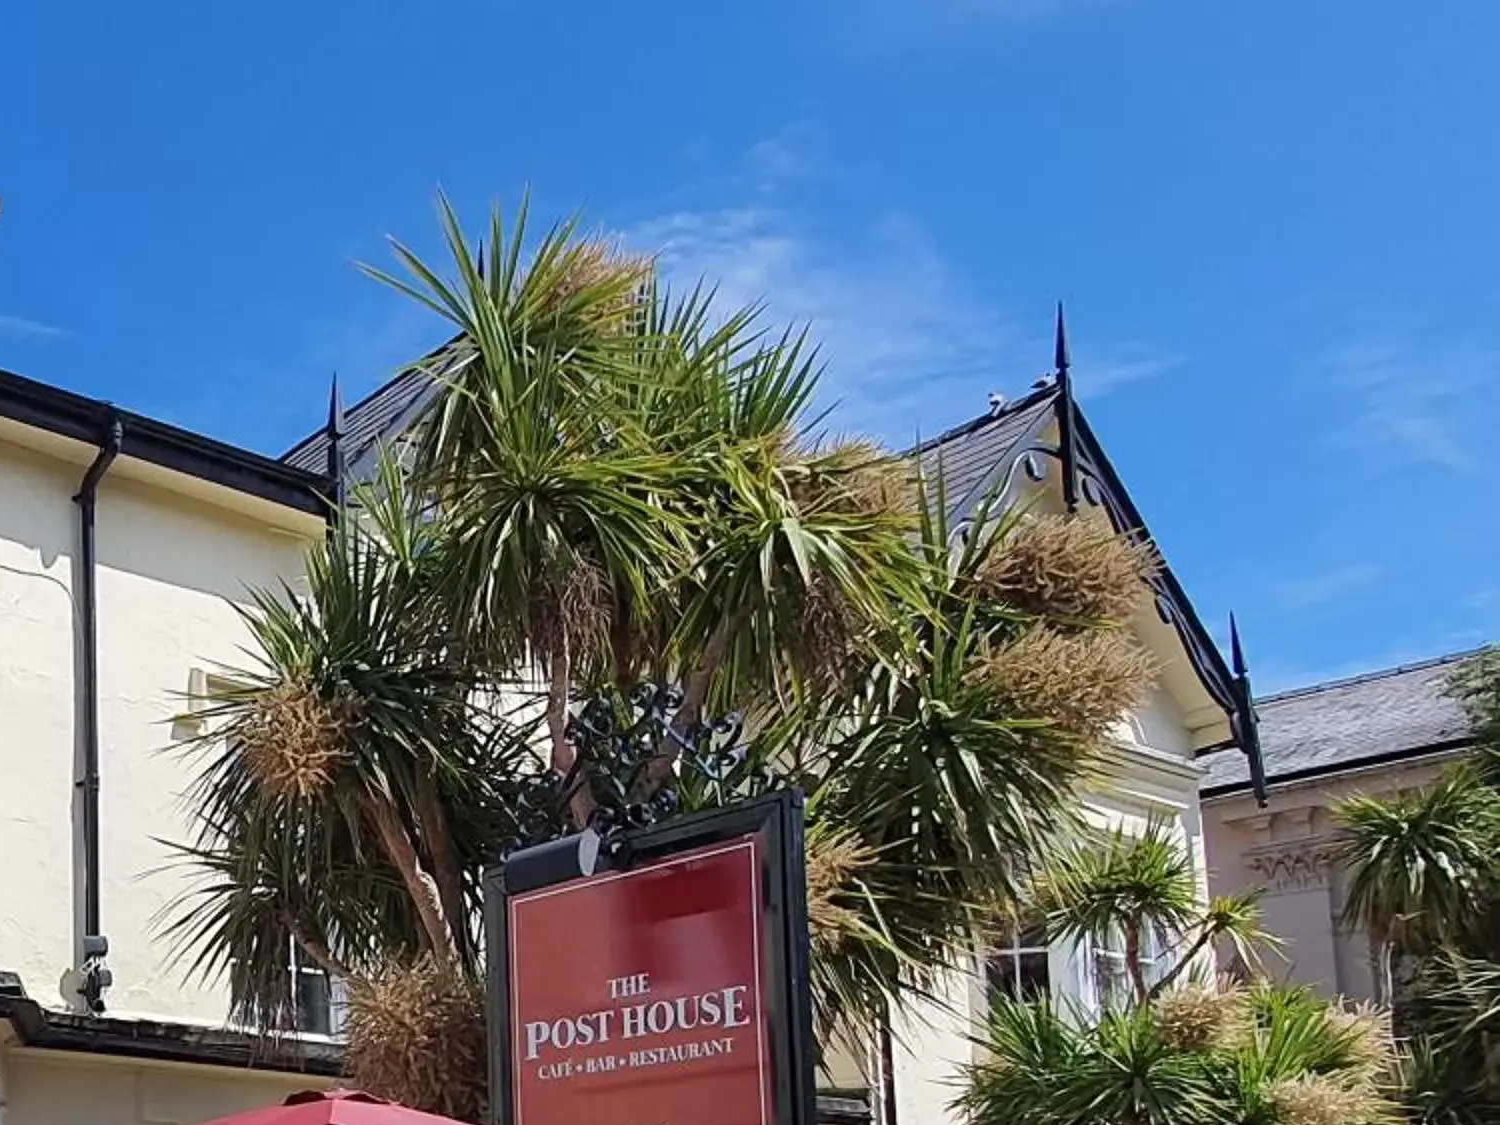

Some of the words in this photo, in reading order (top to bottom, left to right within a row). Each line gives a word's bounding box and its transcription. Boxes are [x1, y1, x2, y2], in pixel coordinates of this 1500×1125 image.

[607, 973, 650, 999] THE
[524, 1009, 615, 1061] POST
[621, 985, 751, 1039] HOUSE
[538, 1058, 574, 1080] CAFÉ
[586, 1055, 616, 1073] BAR
[629, 1037, 736, 1067] RESTAURANT
